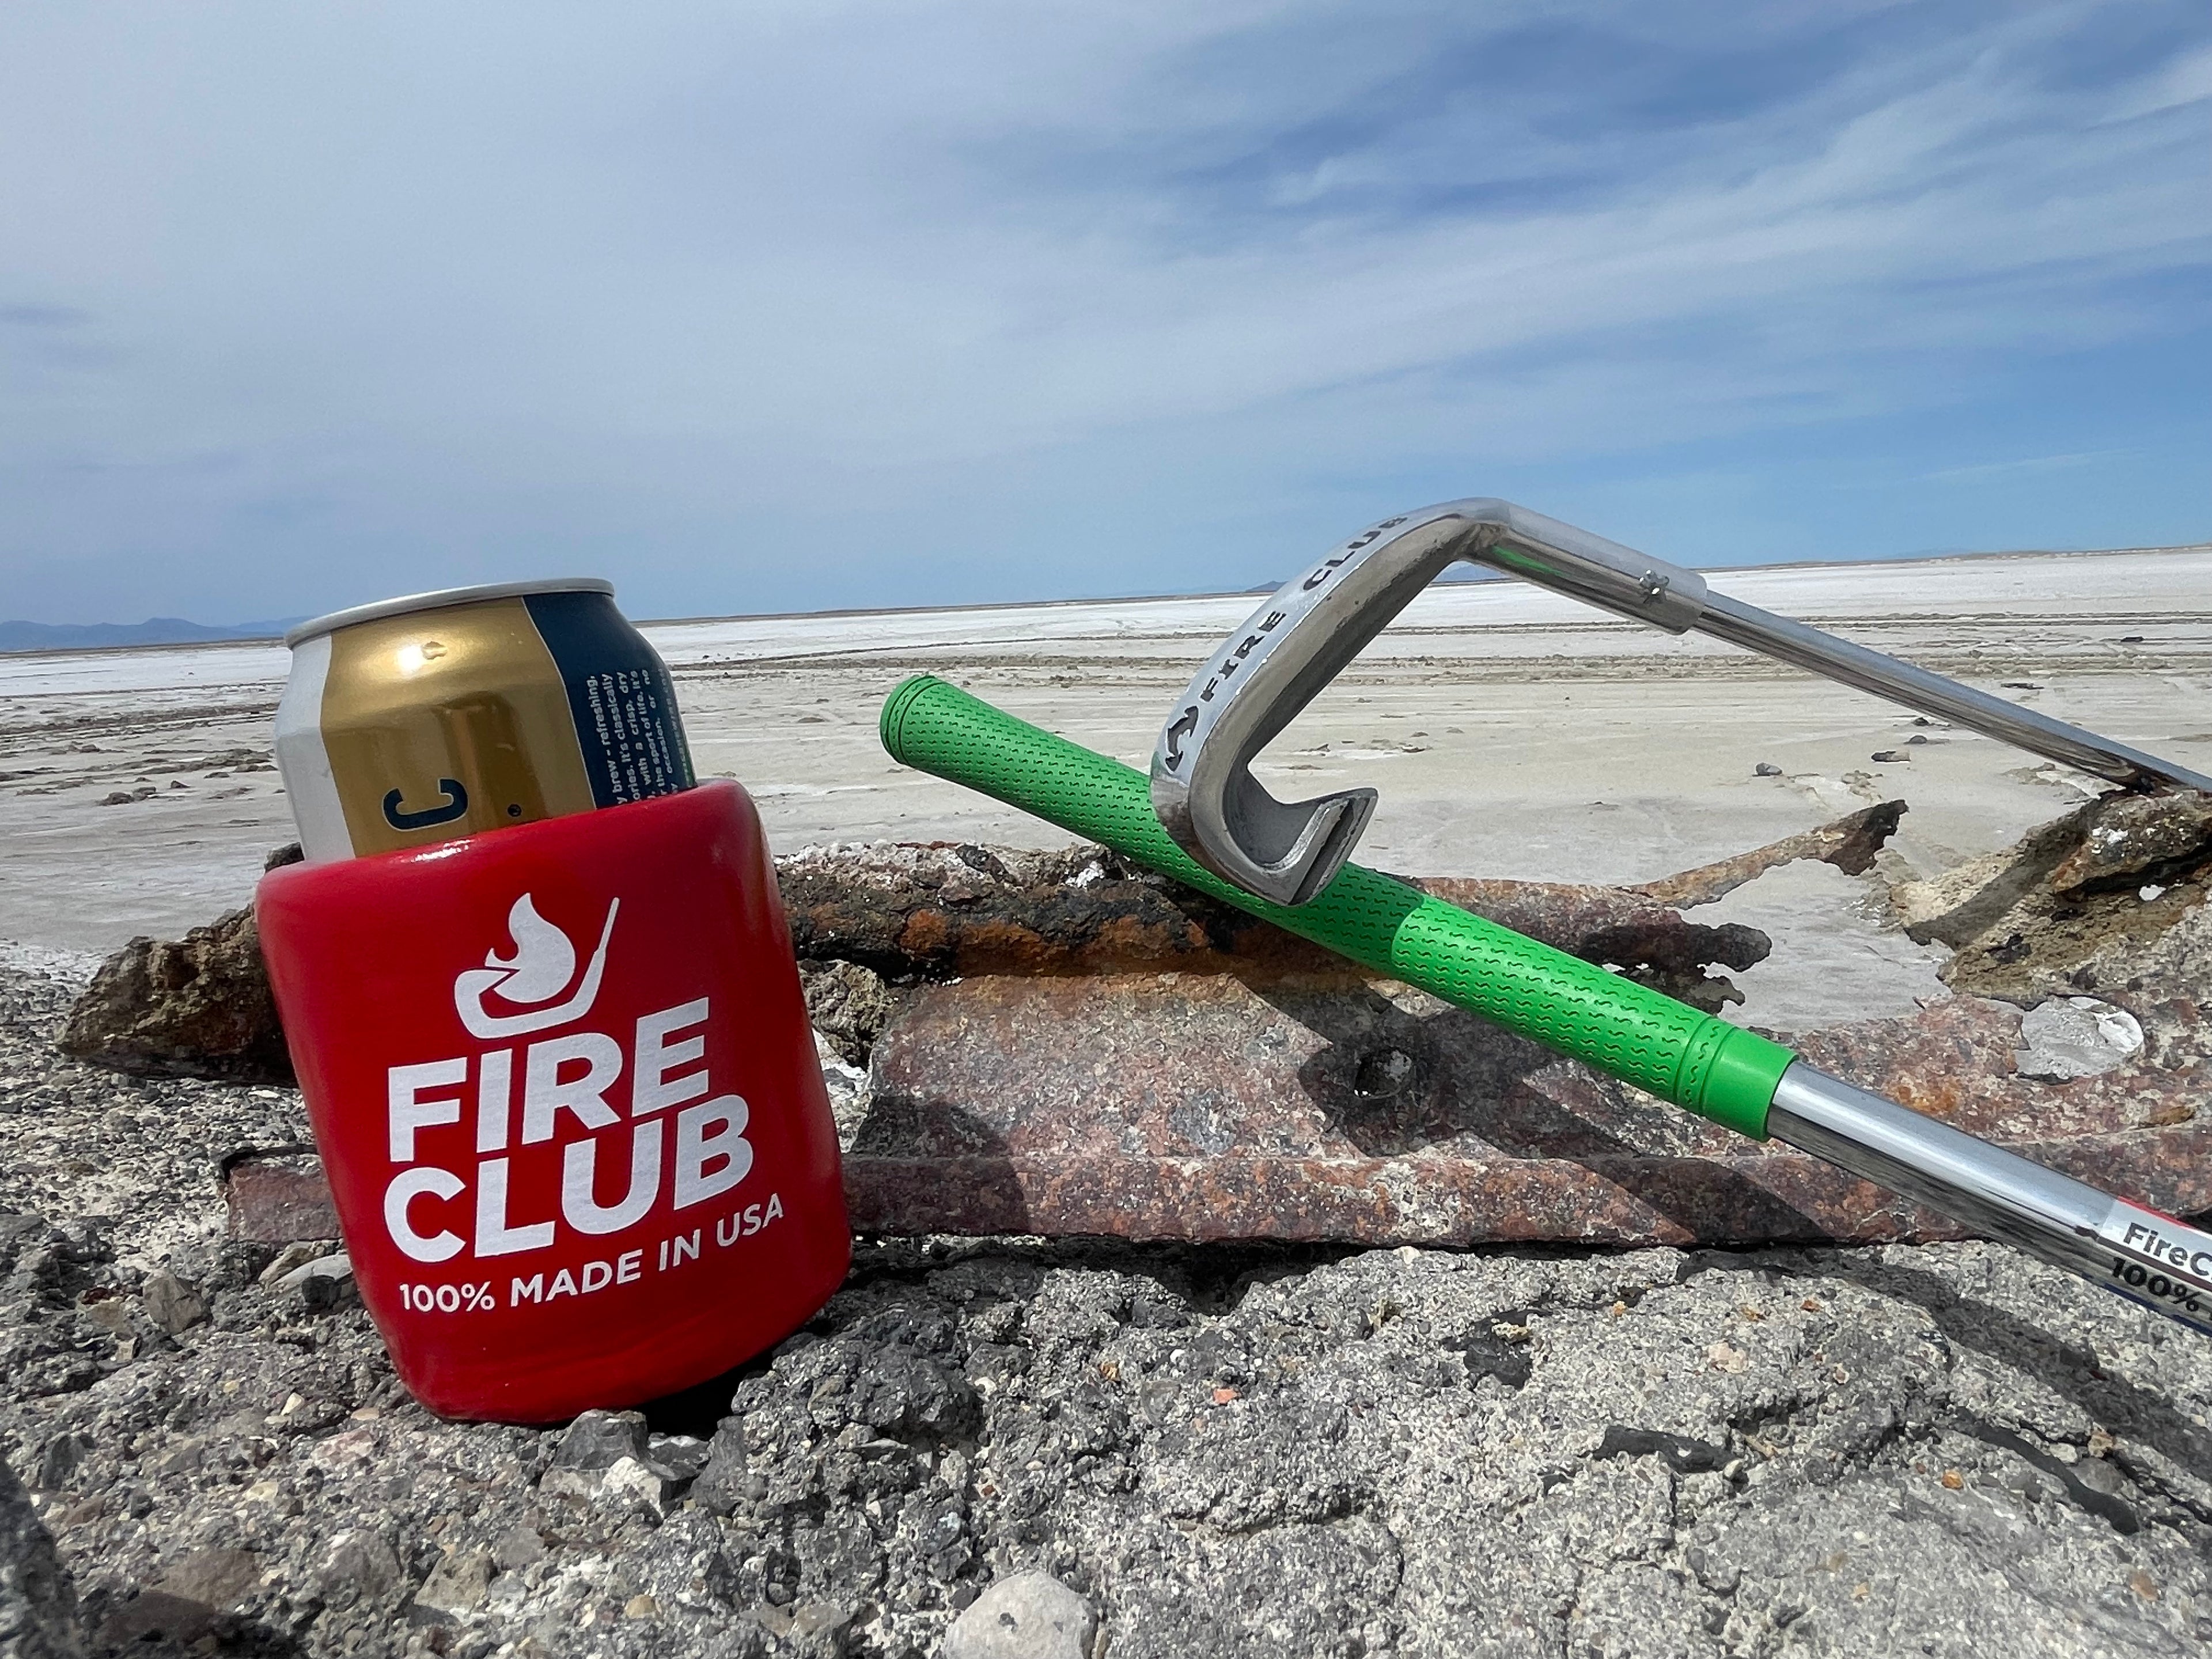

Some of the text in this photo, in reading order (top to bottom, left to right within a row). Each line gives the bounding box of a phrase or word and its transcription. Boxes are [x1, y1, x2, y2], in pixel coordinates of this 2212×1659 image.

[1200, 517, 1408, 702] FIRE CLUB
[616, 672, 628, 693] dry
[642, 669, 650, 685] no
[586, 676, 611, 745] refreshing,
[601, 673, 626, 740] classically
[641, 717, 651, 729] of
[648, 695, 656, 709] or
[635, 742, 643, 751] a
[607, 760, 623, 793] brew
[638, 757, 652, 785] with
[656, 766, 665, 787] the
[388, 997, 709, 1162] FIRE
[384, 1094, 753, 1263] CLUB
[400, 1193, 783, 1312] 100% MADE IN USA
[2123, 1222, 2212, 1276] FireC
[2112, 1257, 2202, 1312] 100%
